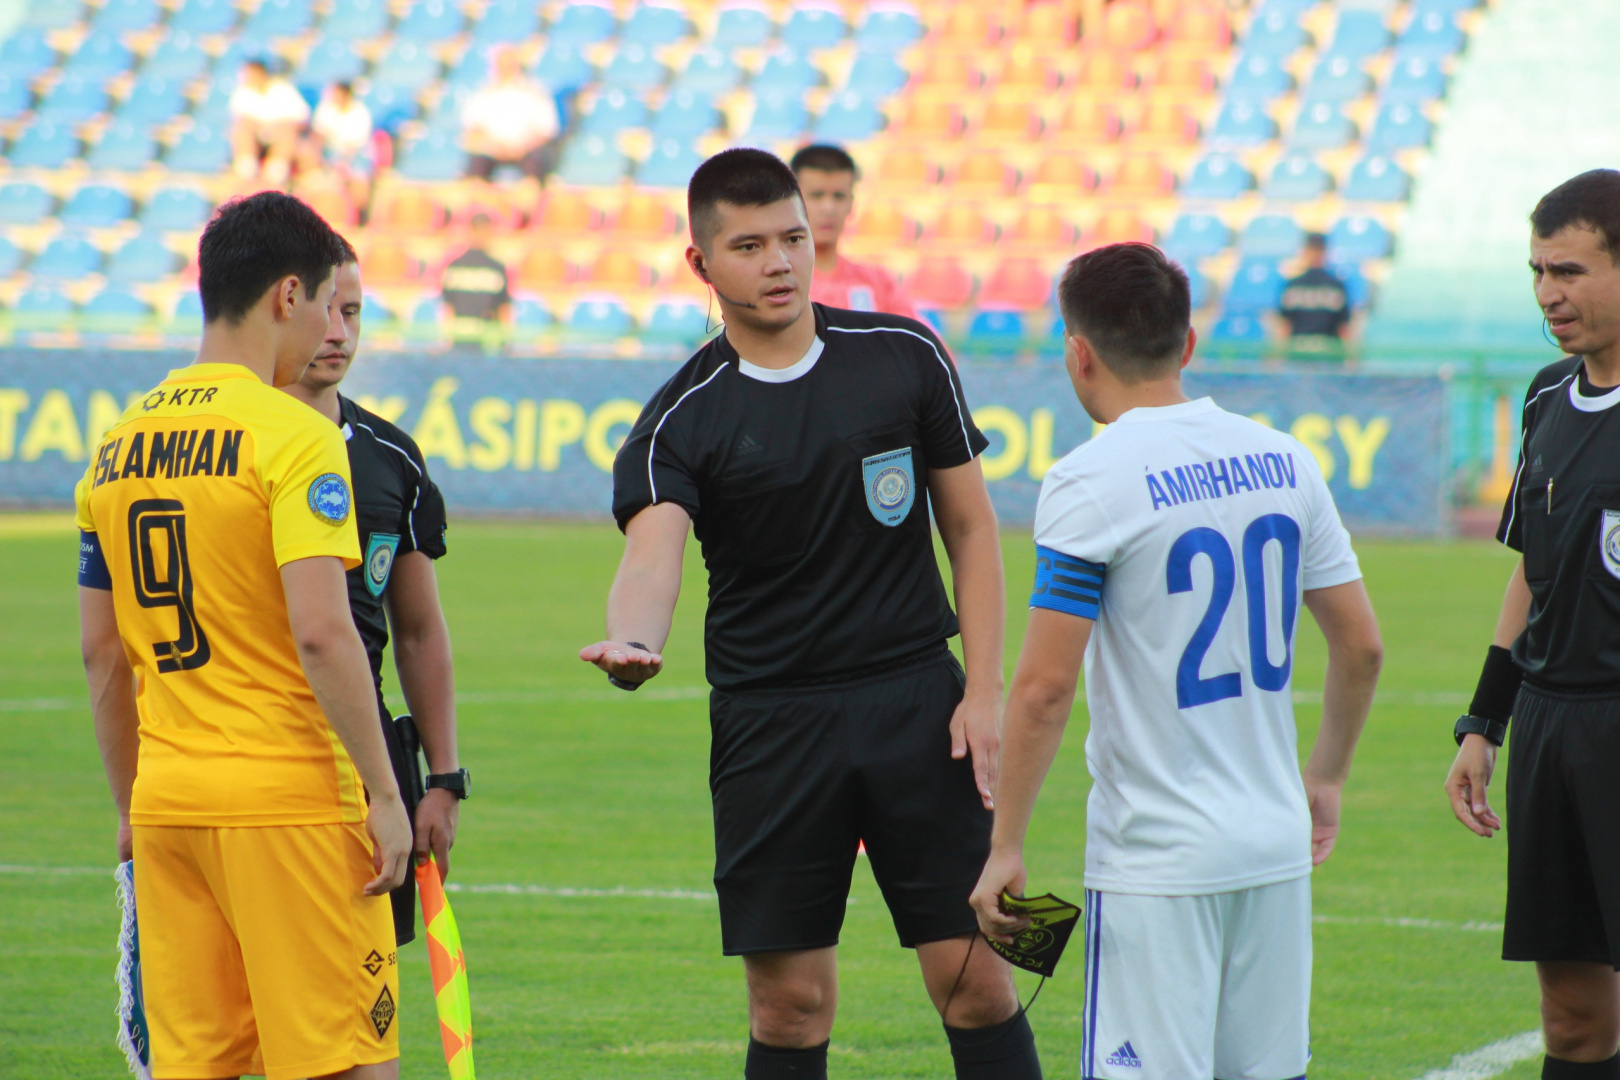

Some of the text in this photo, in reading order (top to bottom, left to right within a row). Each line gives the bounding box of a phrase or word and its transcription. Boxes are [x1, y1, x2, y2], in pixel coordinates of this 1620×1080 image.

[168, 387, 218, 406] KTR
[91, 429, 244, 491] ISLAMHAN
[1145, 452, 1297, 511] ÁMIRHANOV
[128, 498, 211, 673] 9
[1166, 513, 1301, 709] 20
[1106, 1057, 1142, 1068] adidas
